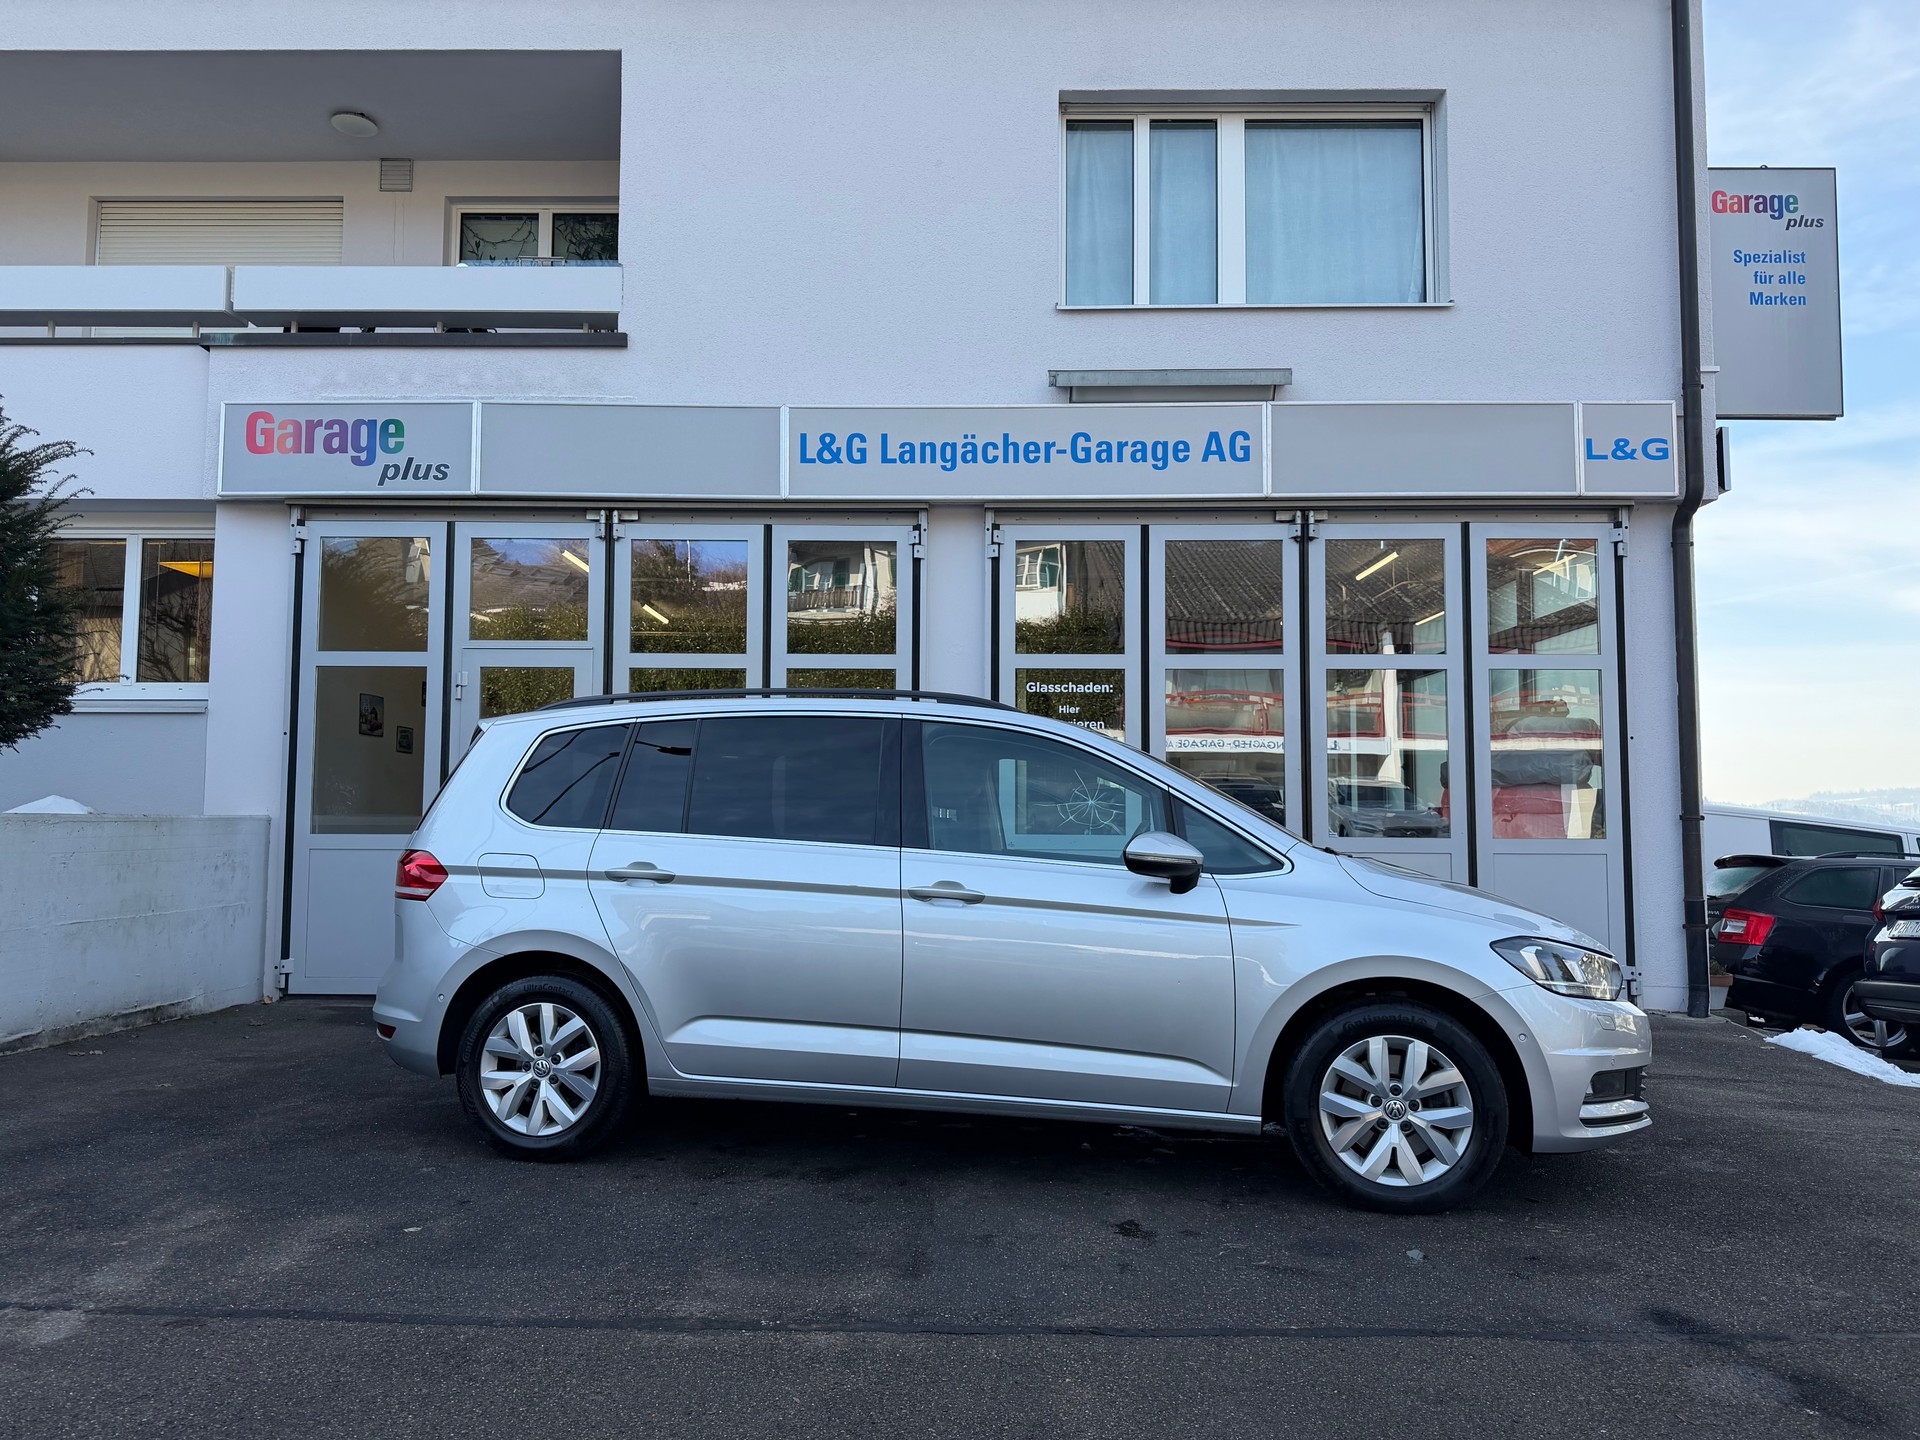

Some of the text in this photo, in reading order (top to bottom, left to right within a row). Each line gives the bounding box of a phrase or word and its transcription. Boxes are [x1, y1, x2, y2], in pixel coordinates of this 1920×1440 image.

[1711, 190, 1799, 220] Garage
[1785, 215, 1825, 231] plus
[1733, 249, 1806, 267] Spezialist
[1753, 270, 1806, 285] für alle
[1749, 291, 1806, 306] Marken
[245, 410, 405, 467] Garage
[799, 430, 1251, 472] L&G Langächer-Garage AG
[1585, 437, 1669, 461] L&G
[376, 456, 451, 486] plus
[1026, 681, 1114, 693] Glasschaden:
[1058, 705, 1081, 714] Hier
